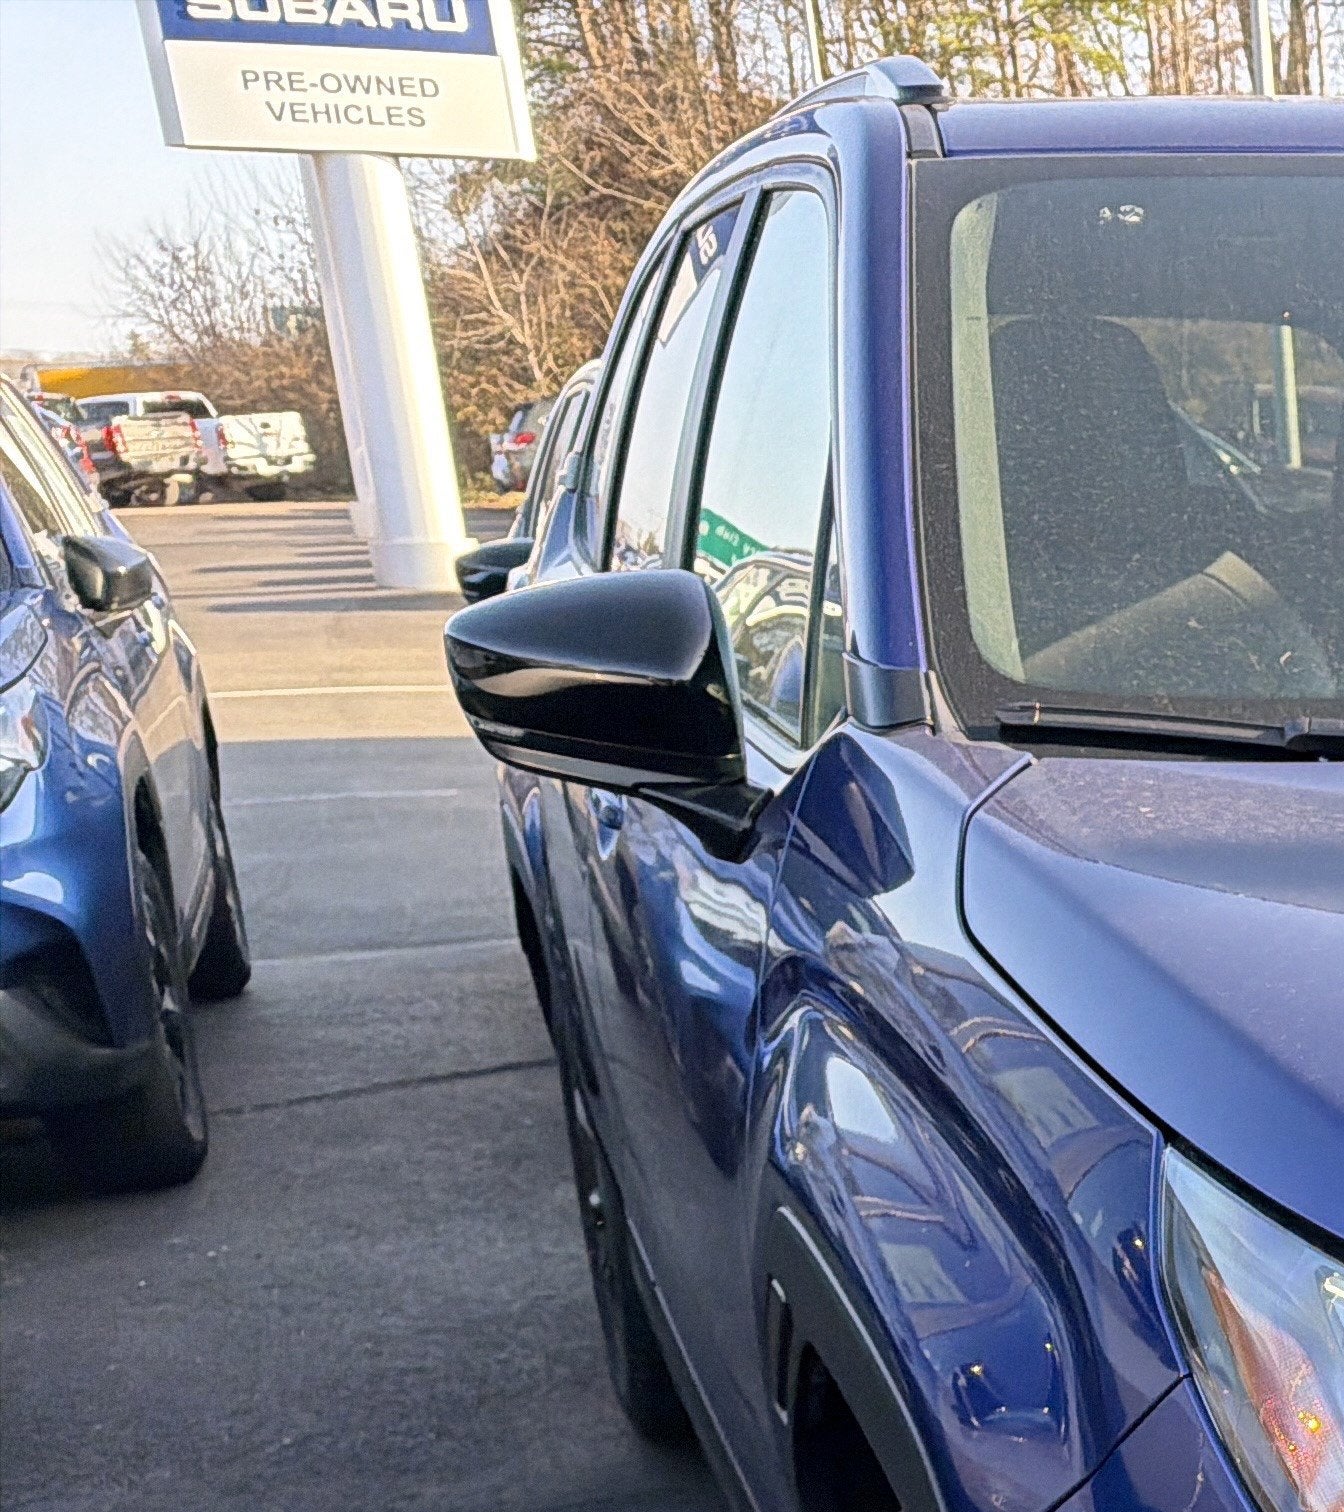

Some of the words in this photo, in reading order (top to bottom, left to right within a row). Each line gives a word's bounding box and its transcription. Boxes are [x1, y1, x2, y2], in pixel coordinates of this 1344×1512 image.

[186, 0, 469, 33] SUBARU
[241, 69, 441, 99] PRE-OWNED
[265, 100, 427, 128] VEHICLES
